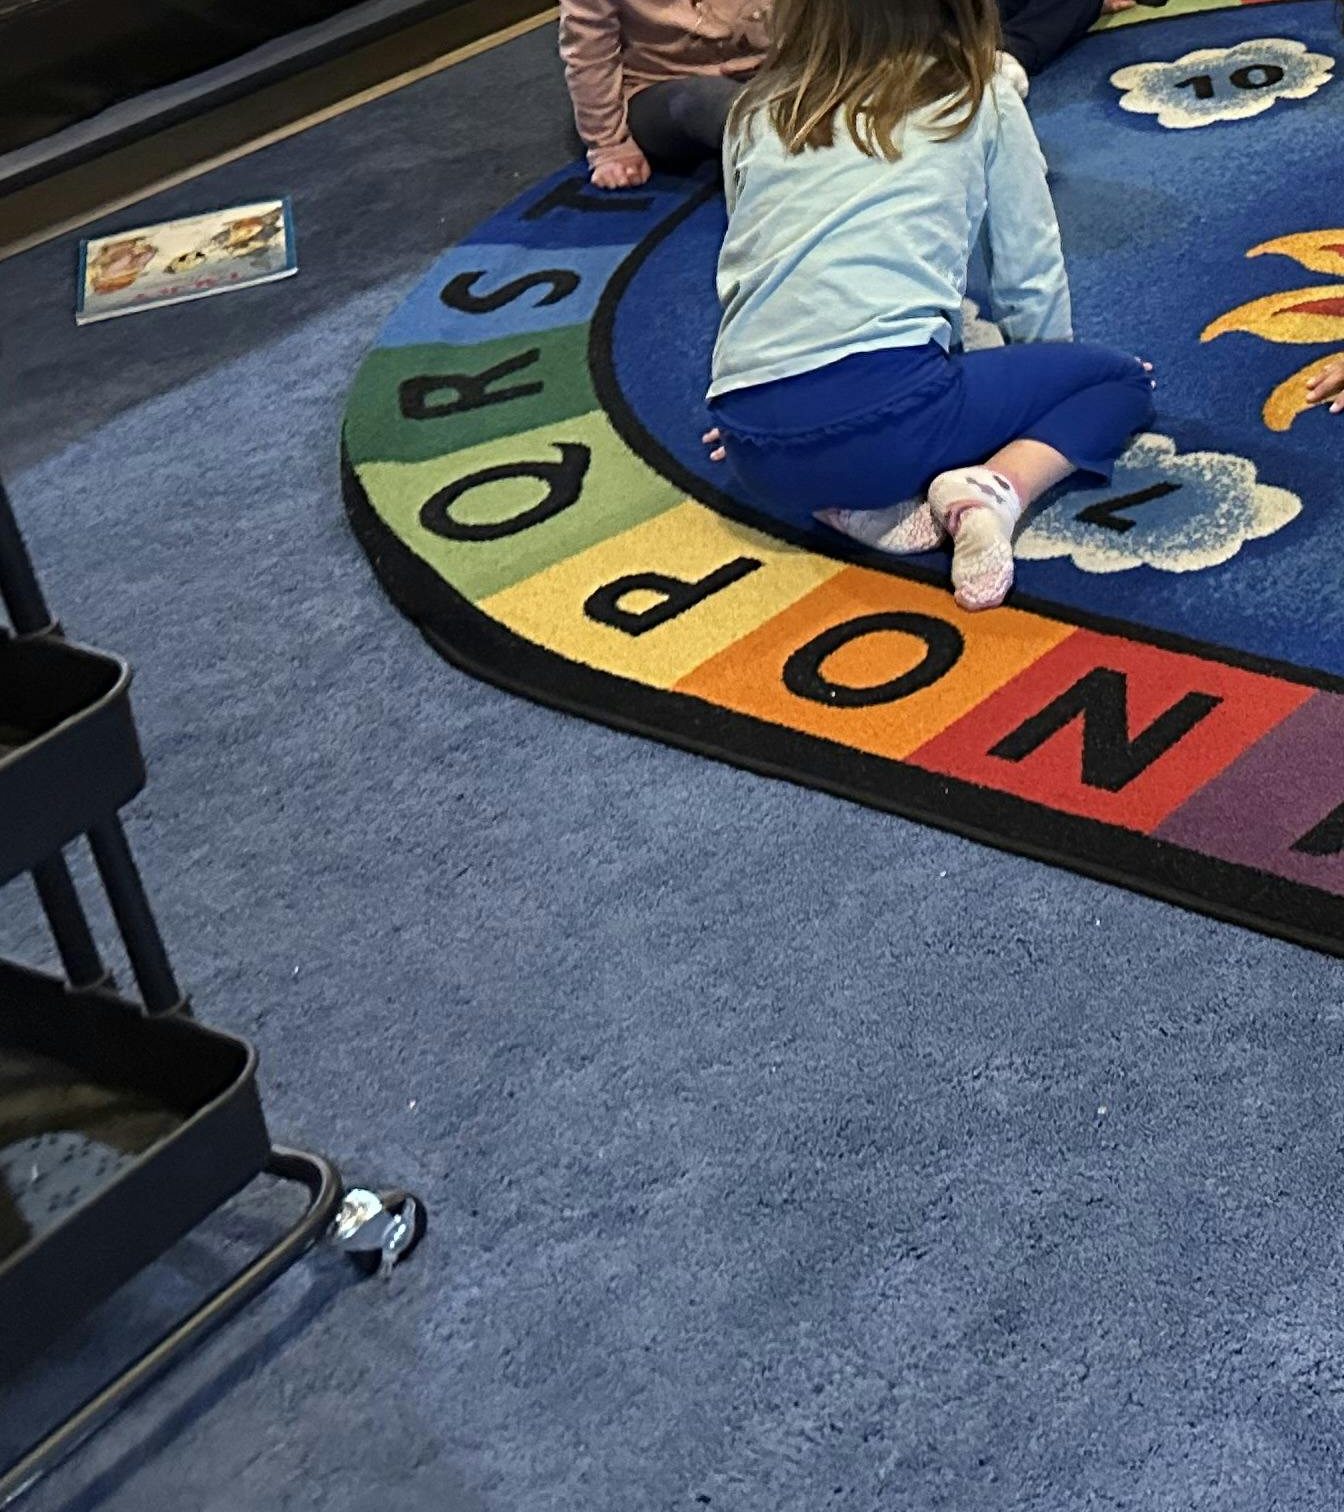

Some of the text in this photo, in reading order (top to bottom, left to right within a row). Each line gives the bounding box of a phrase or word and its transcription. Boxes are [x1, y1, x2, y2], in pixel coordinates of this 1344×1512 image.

[1174, 64, 1285, 100] 10
[440, 268, 581, 315] S
[402, 347, 544, 420] R
[419, 441, 592, 543] Q
[583, 556, 767, 638] P
[782, 610, 966, 709] O
[988, 665, 1224, 794] N
